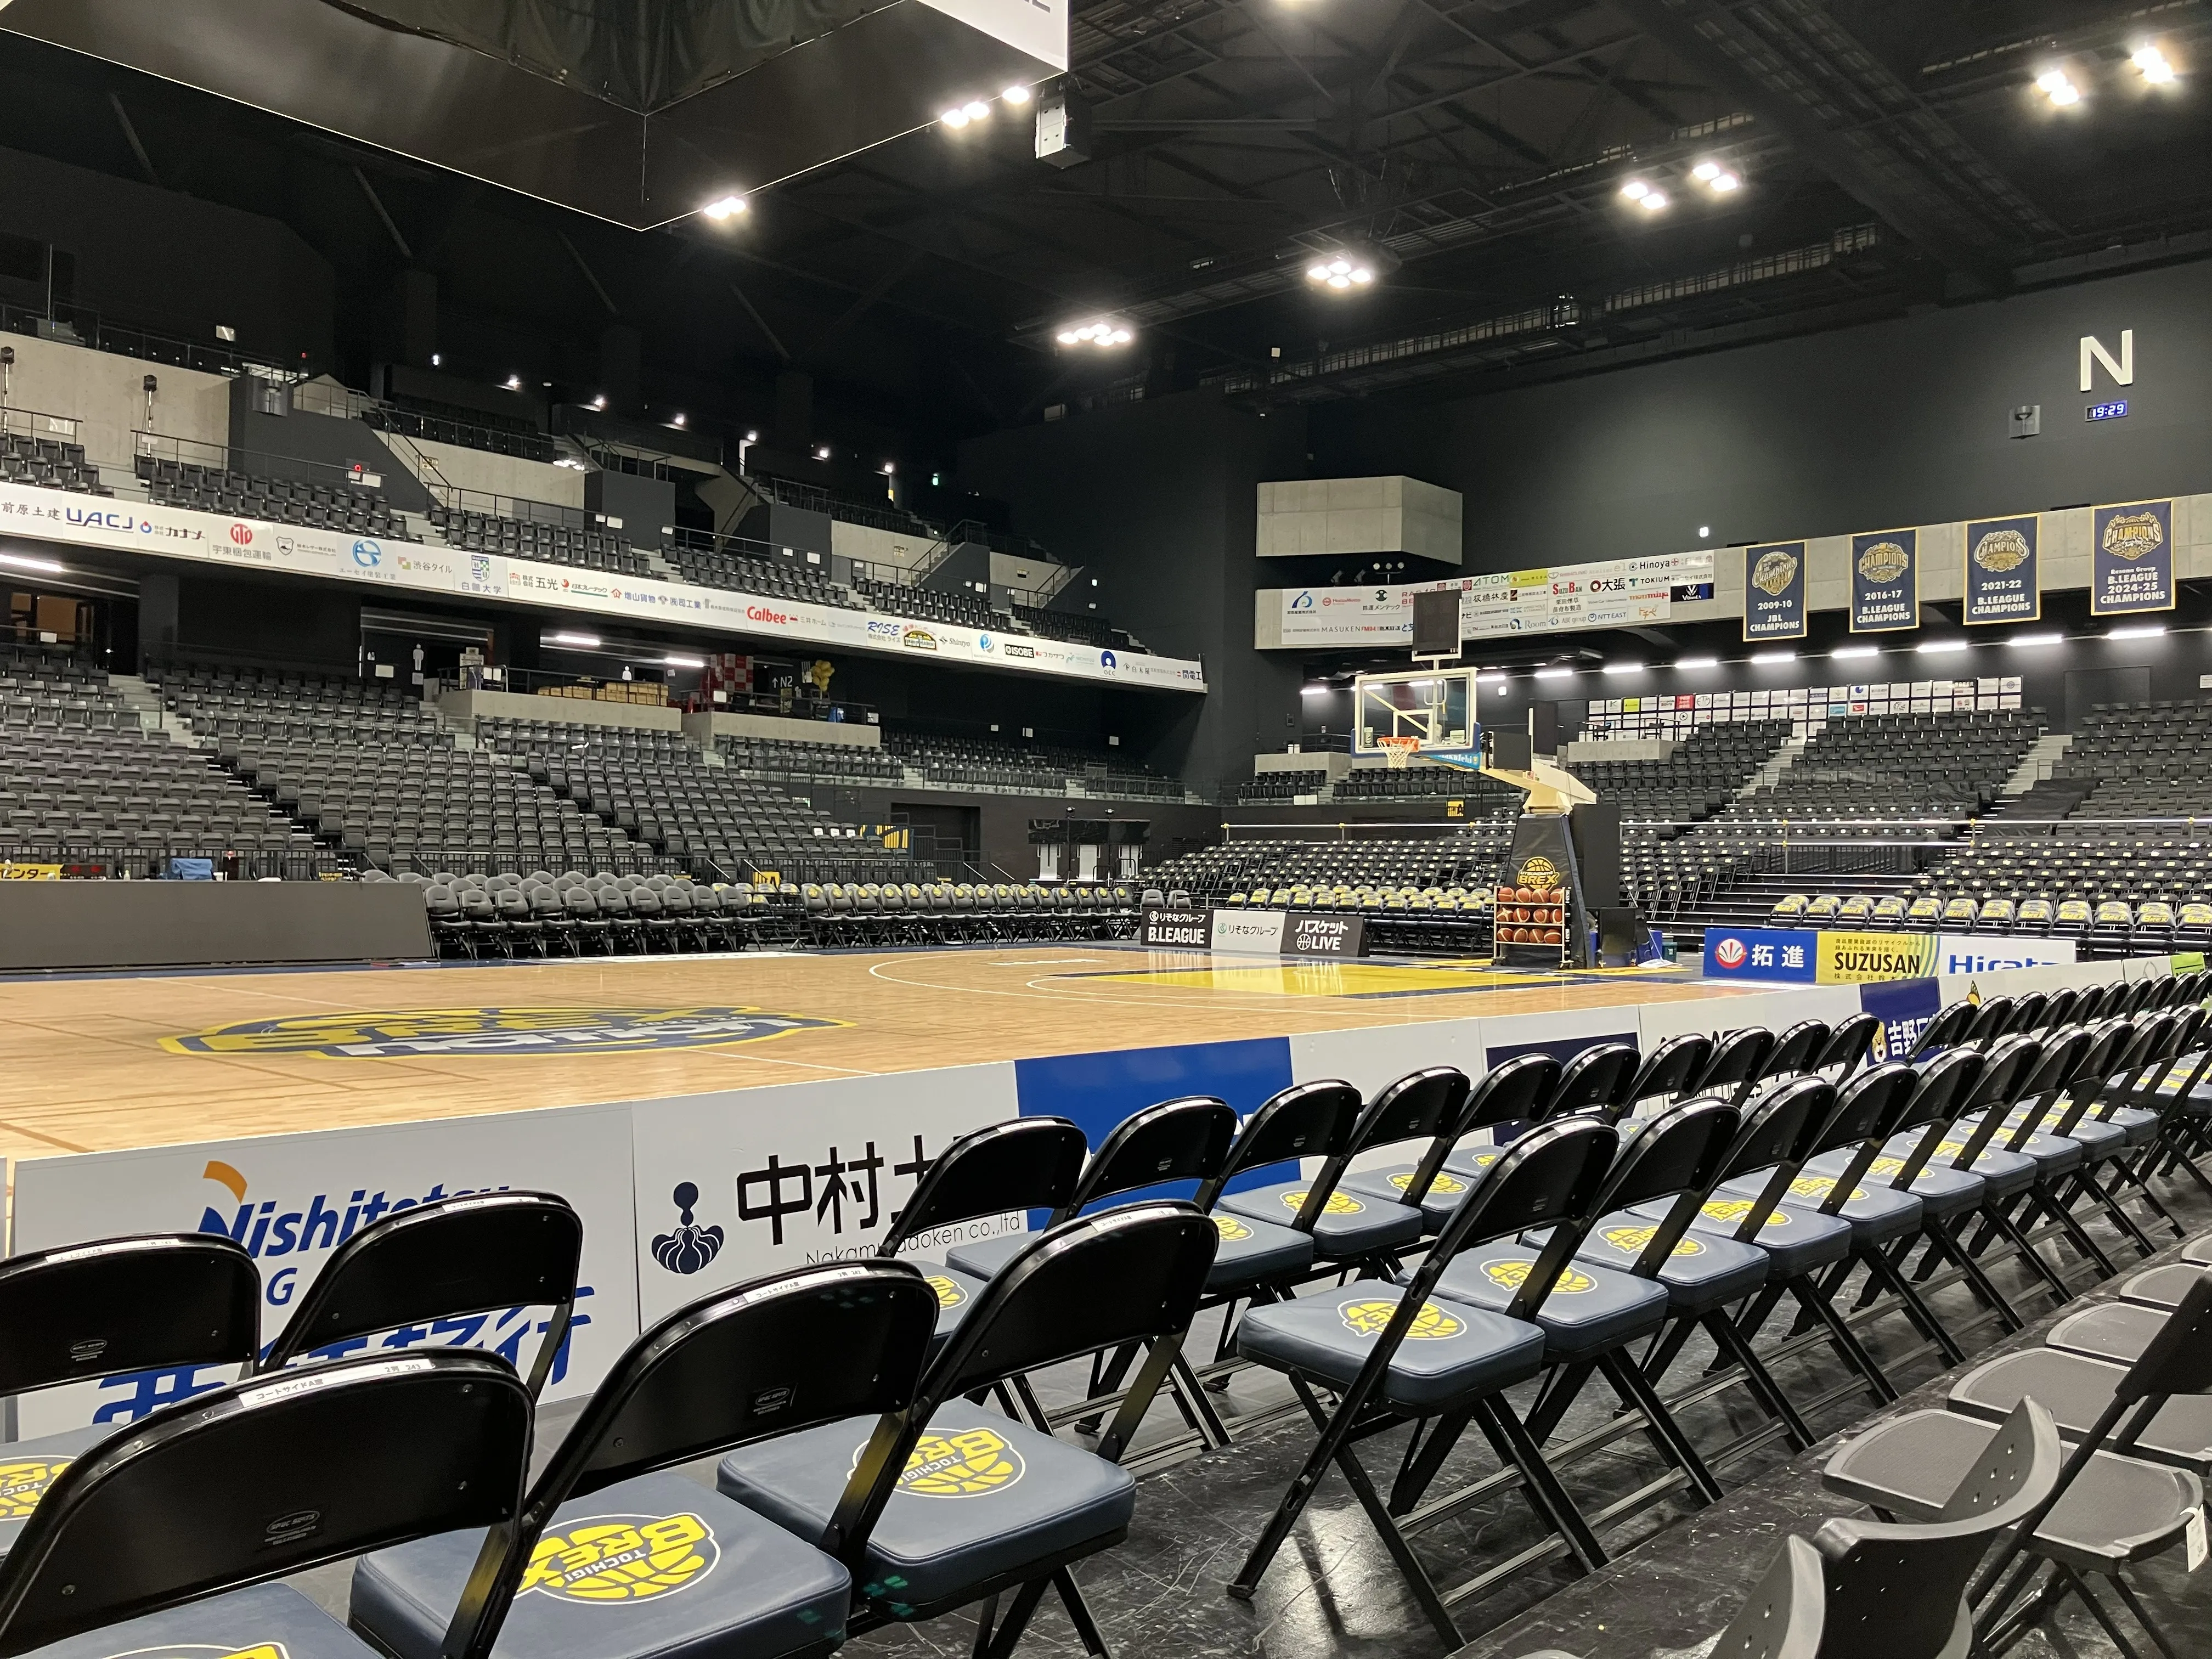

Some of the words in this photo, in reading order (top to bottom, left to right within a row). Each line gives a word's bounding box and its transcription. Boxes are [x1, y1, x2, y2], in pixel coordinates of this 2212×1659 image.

[2080, 329, 2133, 392] N
[2092, 404, 2124, 418] 19:29
[1, 502, 61, 520] 前原土建
[66, 507, 133, 529] UACJ
[2105, 523, 2161, 546] CHAMPIONS
[413, 561, 452, 573] 渋谷タイル
[1640, 560, 1670, 569] Hinoya
[1860, 553, 1907, 571] CHAMPIONS
[535, 577, 558, 590] 五光
[1473, 575, 1509, 586] ATOM
[2108, 572, 2158, 584] B.LEAGUE
[1602, 578, 1626, 592] 大張
[1982, 579, 2022, 591] 2021-22
[2108, 583, 2158, 594] 2024-25
[1865, 590, 1903, 601] 2016-17
[1977, 594, 2025, 606] B.LEAGUE
[2101, 590, 2165, 604] CHAMPIONS
[1758, 600, 1792, 610] 2009-10
[1862, 603, 1905, 614] B.LEAGUE
[1972, 602, 2031, 615] CHAMPIONS
[747, 606, 787, 624] Calbee
[800, 617, 827, 626] 三井ホーム
[1767, 614, 1782, 623] JBL
[1857, 612, 1910, 623] CHAMPIONS
[867, 622, 900, 636] RISE
[1525, 619, 1547, 629] Room
[1750, 621, 1799, 632] CHAMPIONS
[949, 638, 970, 647] Shinryo
[780, 675, 793, 687] N2
[1518, 874, 1560, 885] BREX
[1160, 912, 1206, 923] りそなグループ
[1228, 926, 1279, 936] りそなグループ
[1295, 919, 1348, 935] バスケット
[1148, 926, 1205, 945] B.LEAGUE
[1311, 936, 1341, 951] LIVE
[1752, 944, 1804, 969] 拓進
[1834, 952, 1920, 974] SUZUSAN
[1949, 955, 2060, 974] Hirat
[1888, 1014, 1938, 1056] 吉野
[901, 1455, 961, 1481] TOCHIGI
[564, 1549, 647, 1582] TOCHIGI
